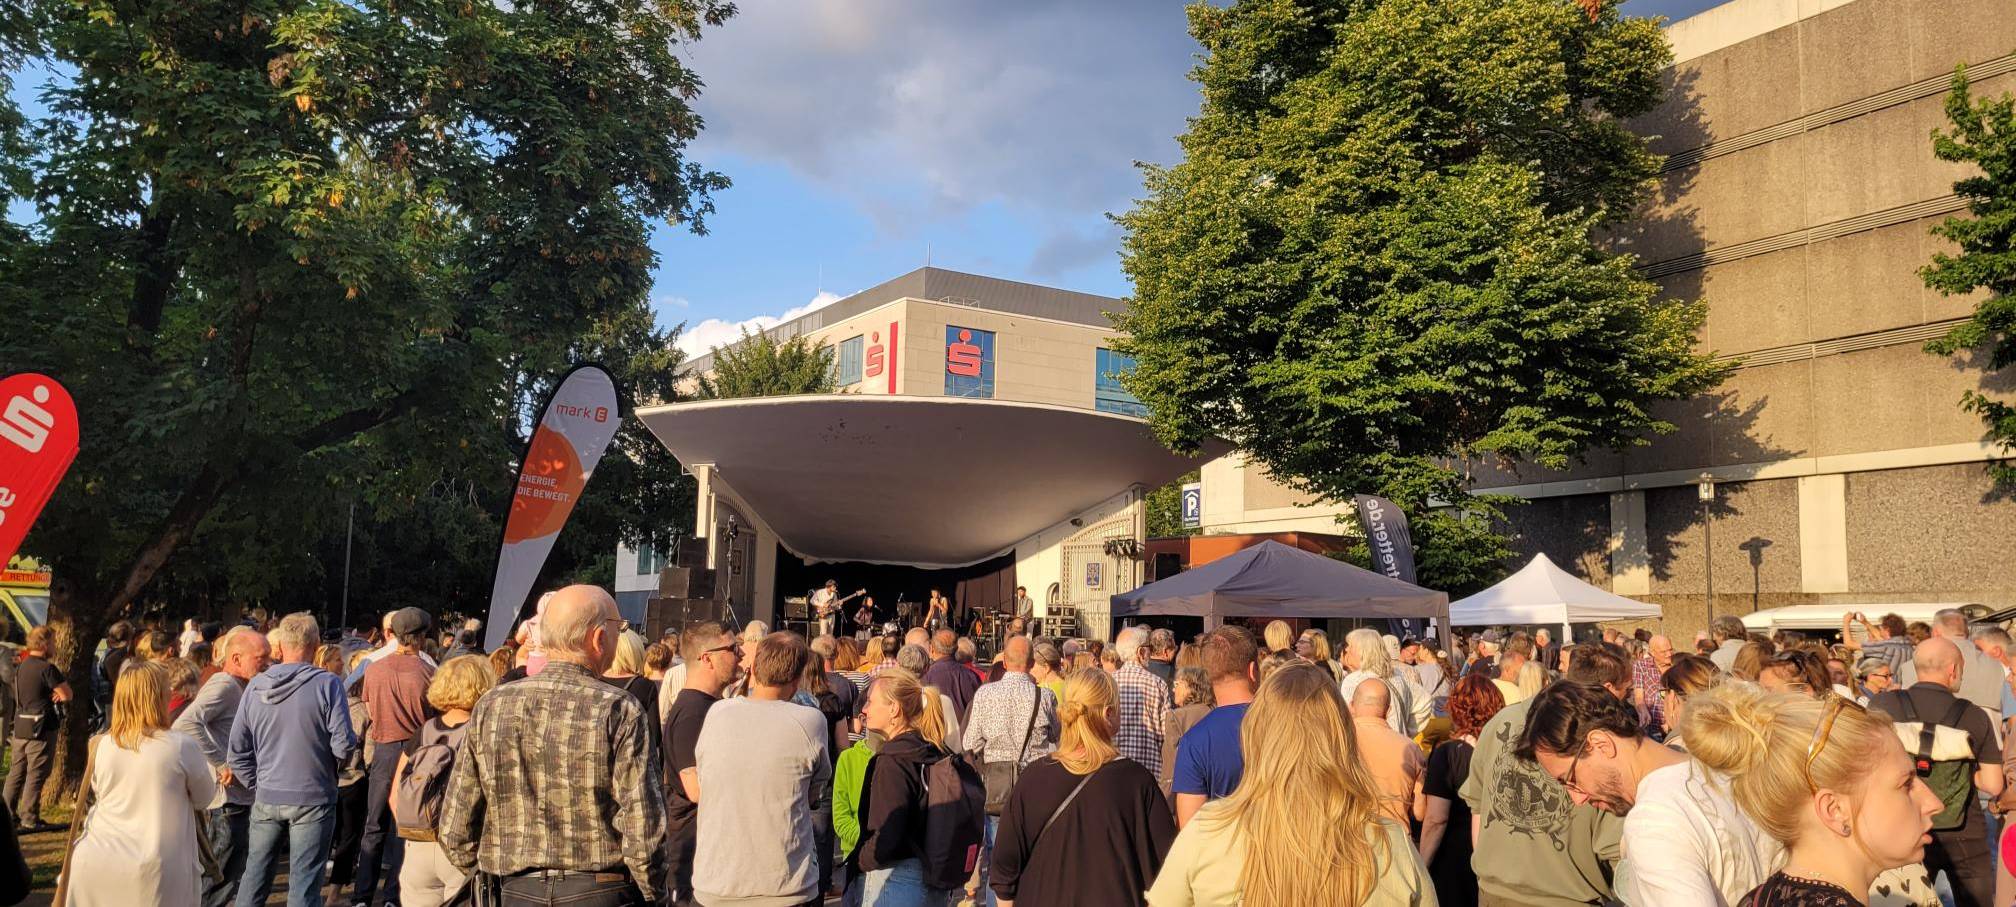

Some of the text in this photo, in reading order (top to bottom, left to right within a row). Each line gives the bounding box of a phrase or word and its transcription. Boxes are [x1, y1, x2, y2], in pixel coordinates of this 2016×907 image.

[556, 404, 591, 419] mark
[520, 473, 558, 489] ENERGIE,
[517, 486, 570, 503] DIE BEWEGT.
[1187, 496, 1197, 517] P
